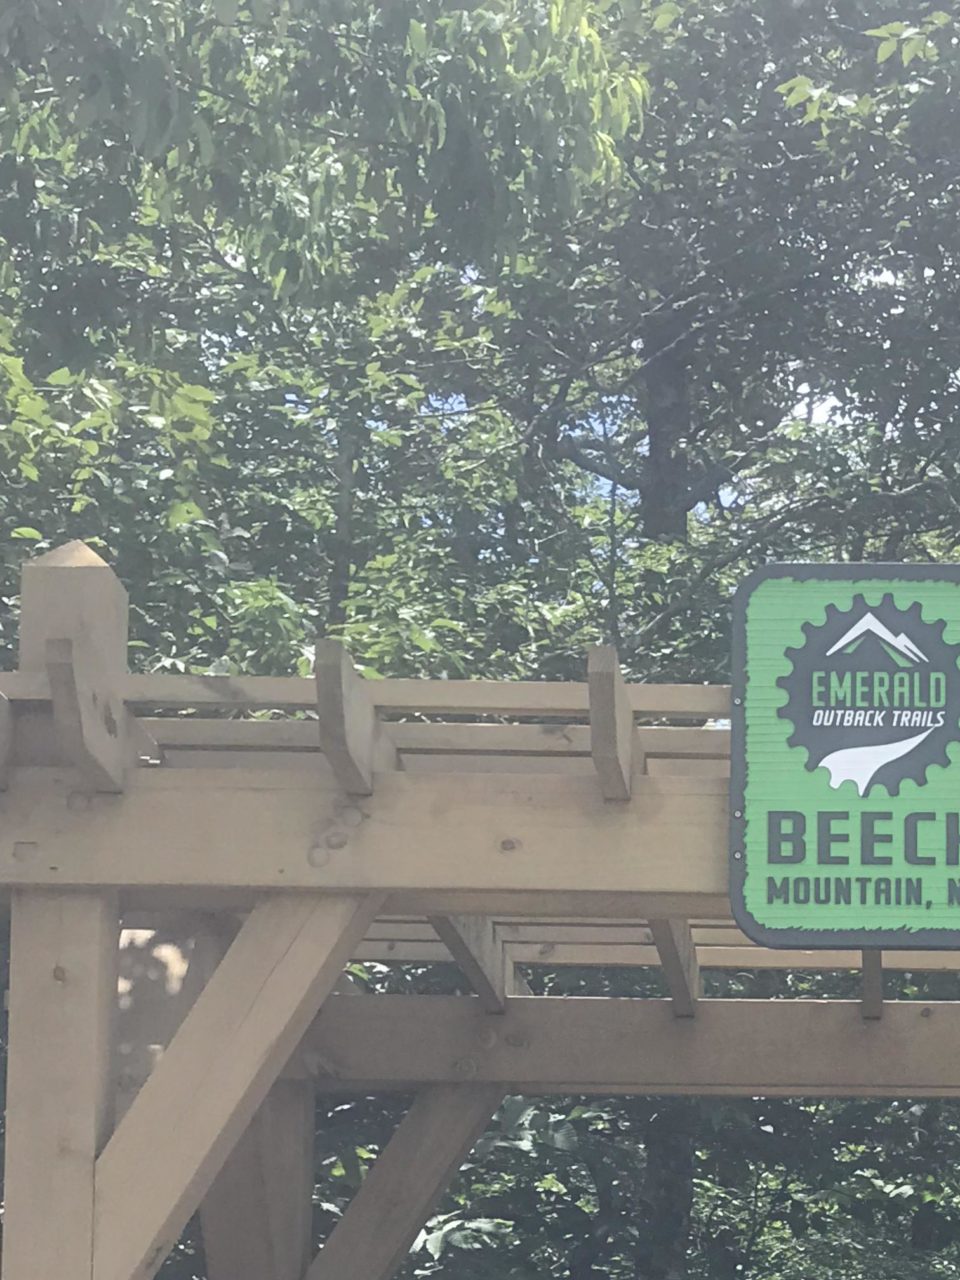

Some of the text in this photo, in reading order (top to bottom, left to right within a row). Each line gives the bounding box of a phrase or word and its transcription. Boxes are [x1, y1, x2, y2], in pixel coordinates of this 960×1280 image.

[812, 671, 947, 708] EMERALD
[812, 709, 946, 727] OUTBACK TRAILS
[766, 876, 933, 909] MOUNTAIN,
